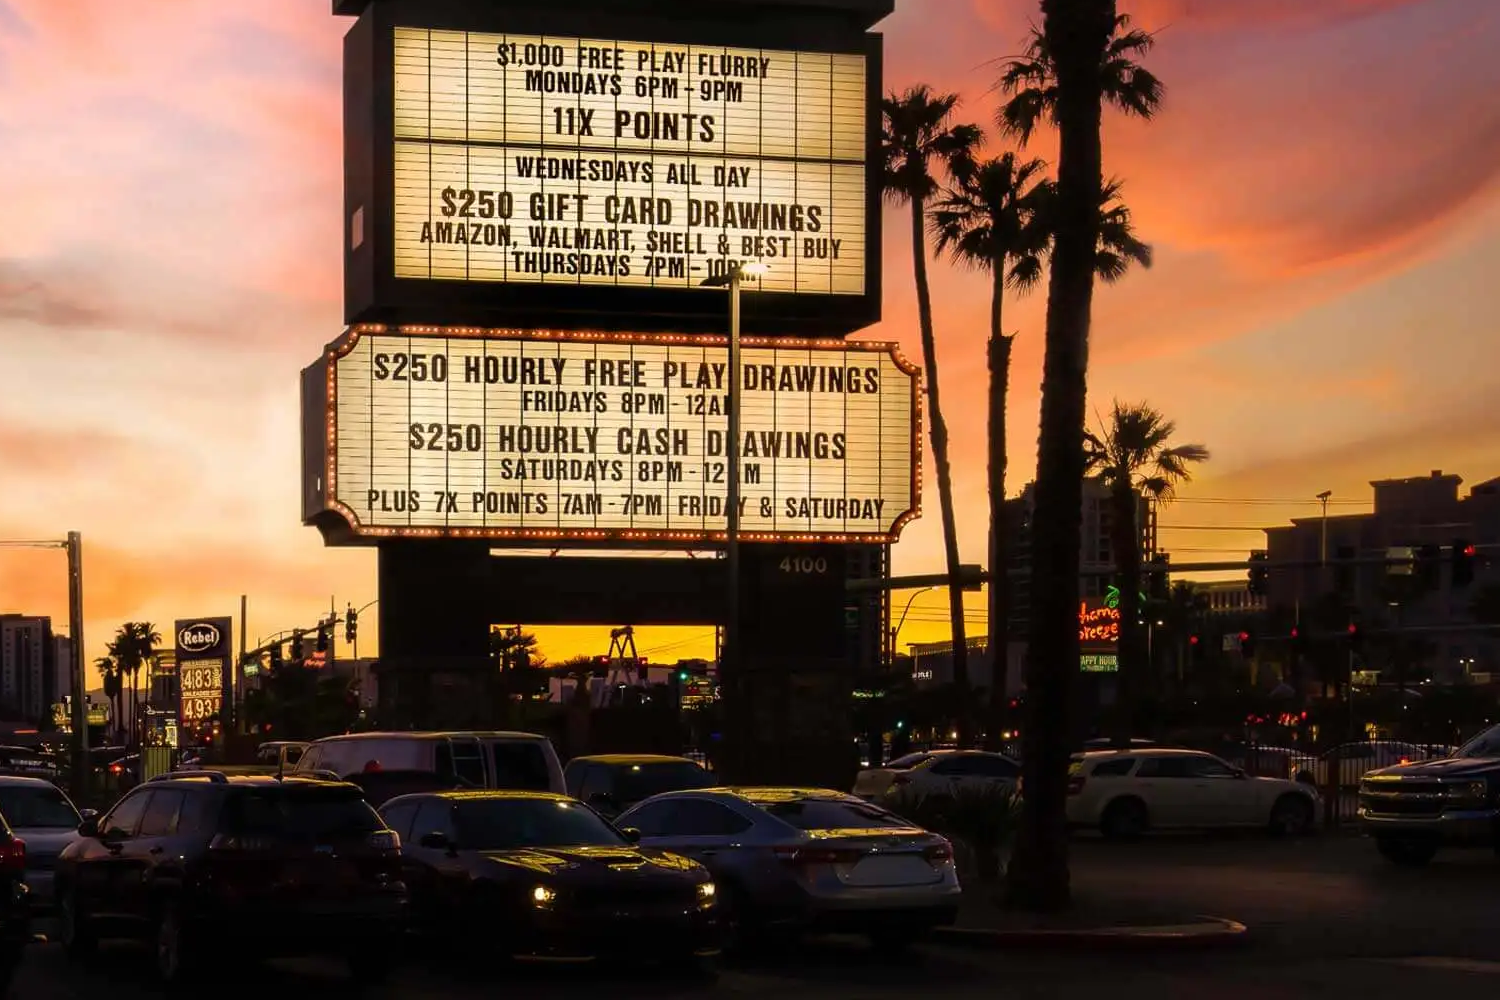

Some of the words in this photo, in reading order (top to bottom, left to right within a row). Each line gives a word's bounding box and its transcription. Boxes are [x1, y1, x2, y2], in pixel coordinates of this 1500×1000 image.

[497, 42, 564, 67] $1,000
[578, 46, 624, 70] FREE
[638, 50, 686, 73] PLAY
[698, 53, 770, 78] FLURRY
[525, 69, 622, 96] MONDAYS
[553, 107, 595, 136] 11X
[615, 110, 715, 142] POINTS
[515, 156, 652, 183] WEDNESDAYS
[667, 163, 702, 185] ALL
[714, 165, 750, 187] DAY
[441, 185, 513, 219] $250
[529, 192, 588, 222] GIFT
[605, 195, 671, 225] CARD
[688, 198, 822, 232] DRAWINGS
[420, 222, 518, 249] AMAZON,
[528, 225, 635, 253] WALMART,
[647, 230, 706, 254] SHELL
[717, 234, 730, 255] &
[741, 235, 790, 258] BEST
[804, 238, 841, 259] BUY
[511, 251, 630, 276] THURSDAYS
[465, 355, 566, 385] HOURLY
[585, 359, 646, 387] FREE
[664, 361, 726, 389] PLAY
[744, 364, 878, 393] DRAWINGS
[522, 391, 607, 412] FRIDAYS
[500, 425, 599, 453] HOURLY
[617, 427, 688, 456] CASH
[707, 430, 845, 459] DAWINGS
[501, 458, 623, 481] SATURDAYS
[703, 462, 760, 484] 12M
[367, 489, 420, 512] PLUS
[434, 491, 458, 513] 7X
[472, 492, 547, 514] POINTS
[760, 496, 772, 517] &
[785, 497, 884, 519] SATURDAY
[779, 555, 827, 574] 4100
[184, 631, 215, 645] Rebel
[1099, 655, 1117, 665] HOUR
